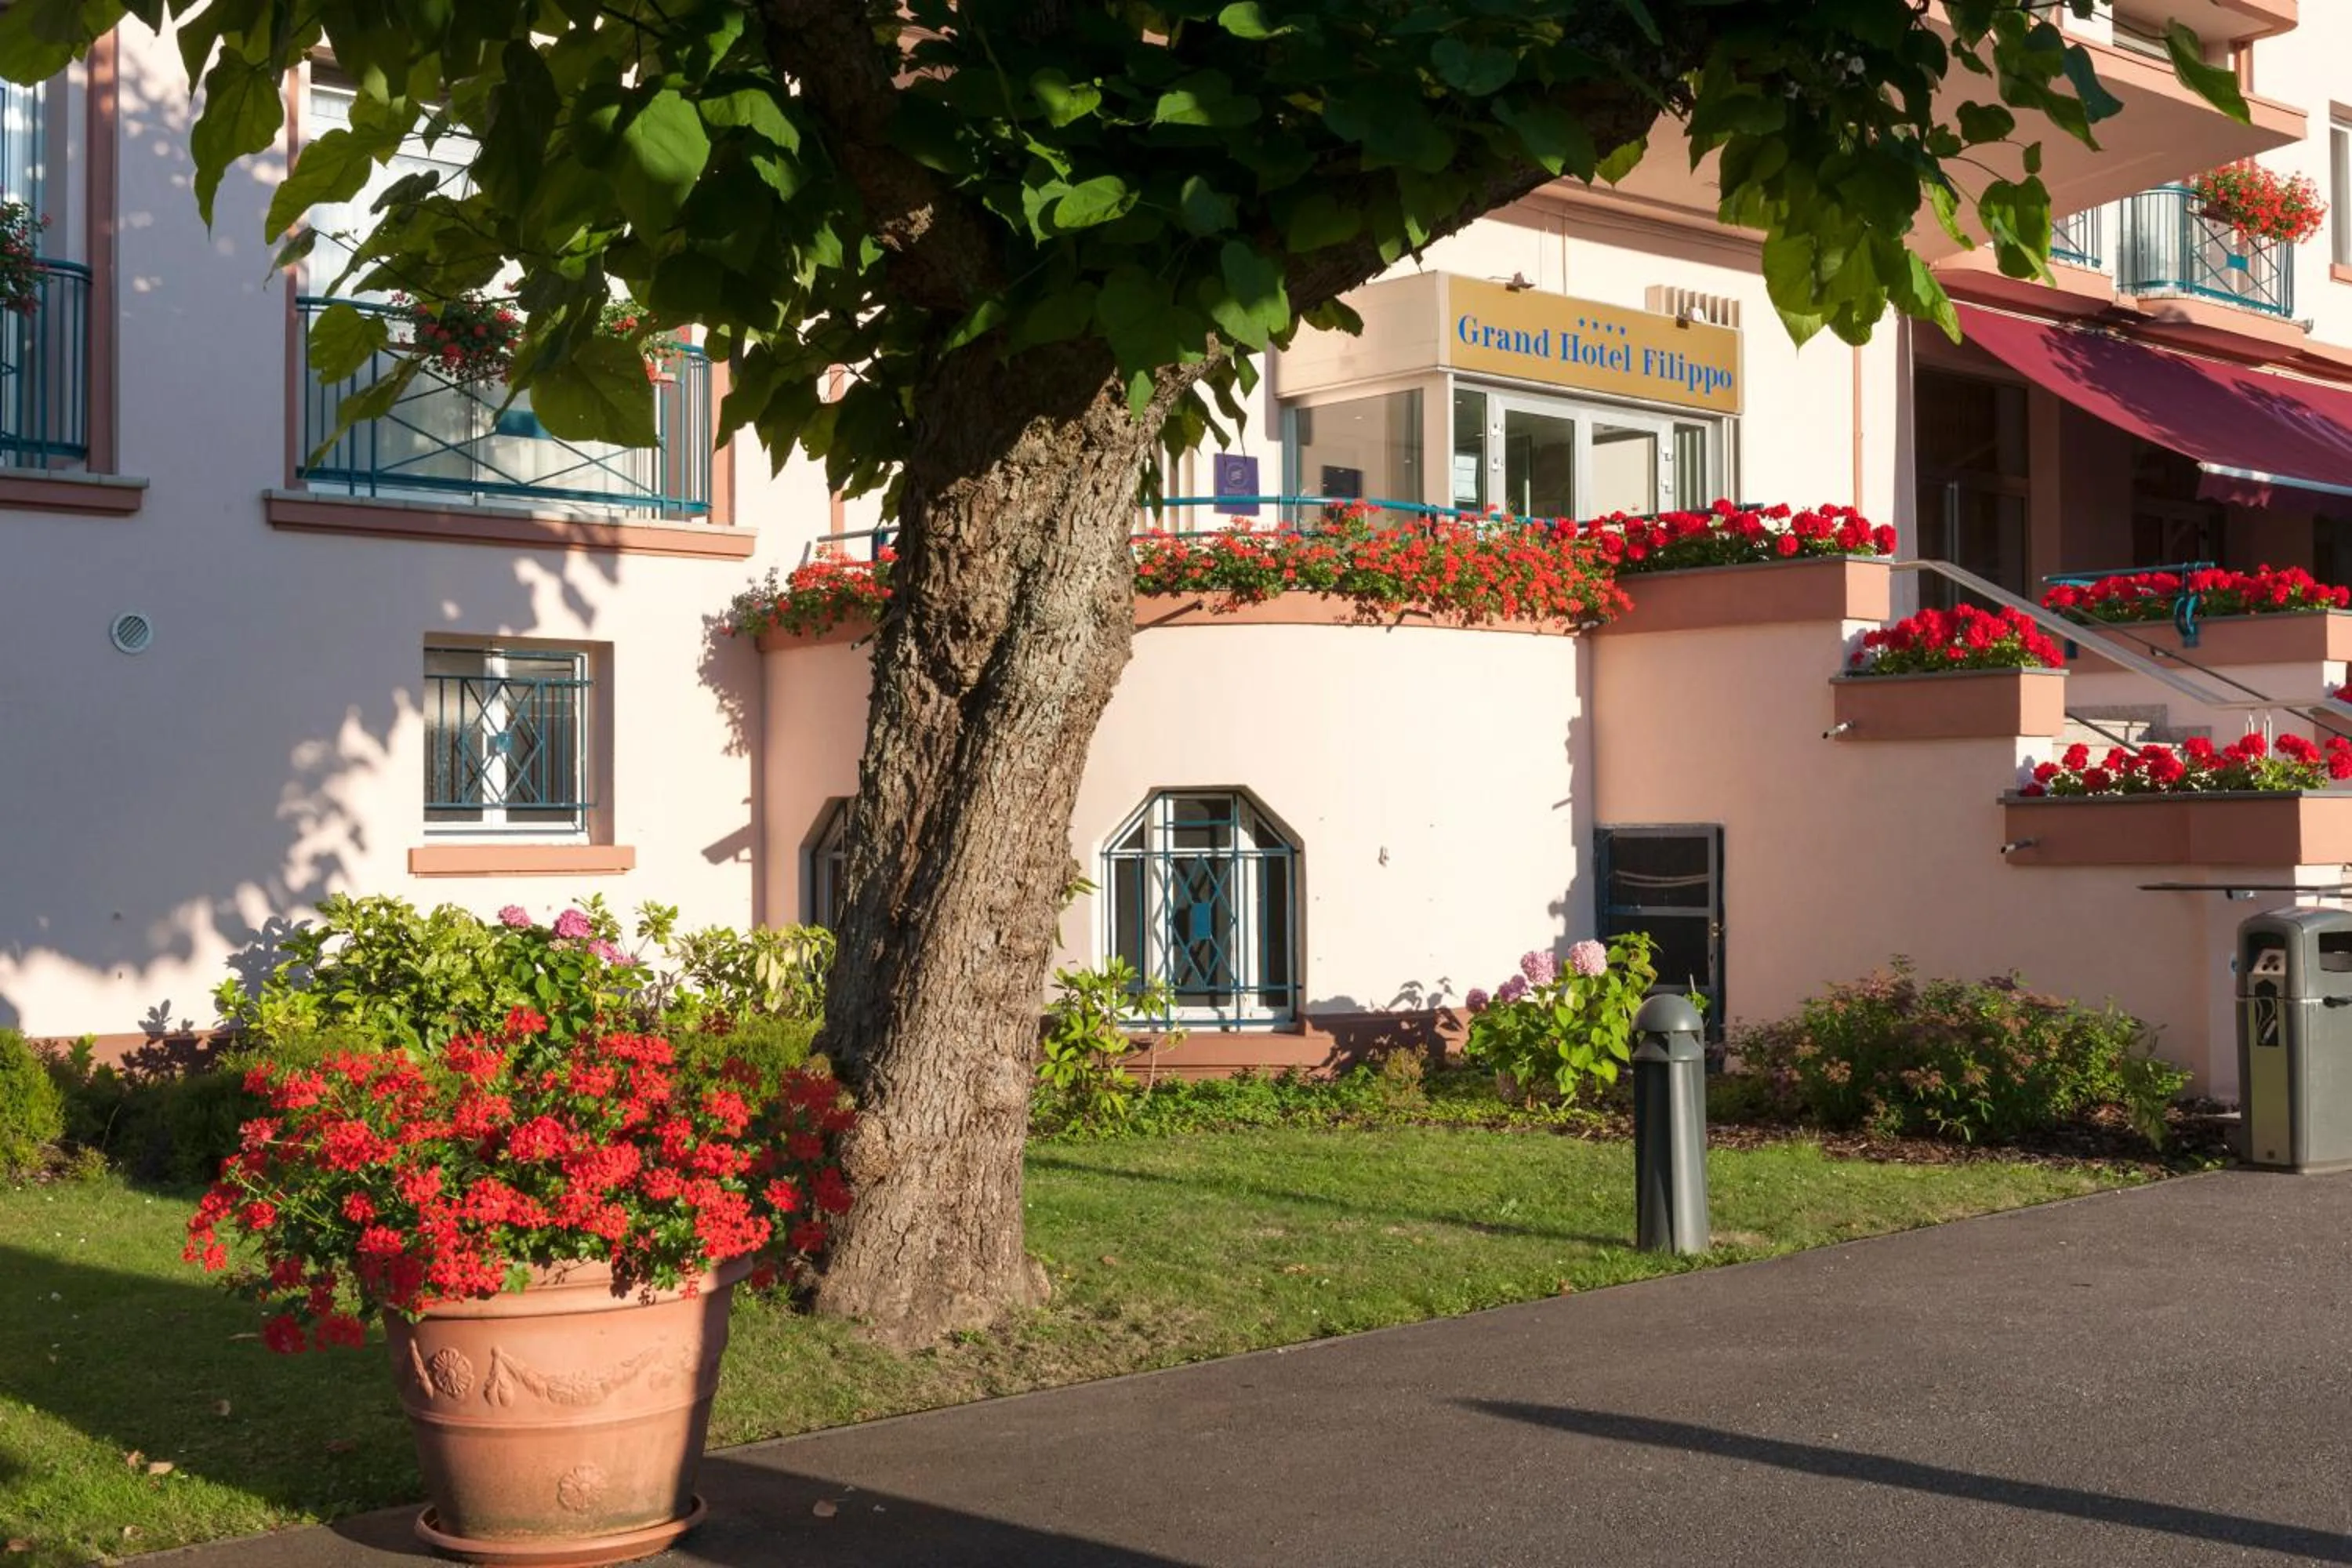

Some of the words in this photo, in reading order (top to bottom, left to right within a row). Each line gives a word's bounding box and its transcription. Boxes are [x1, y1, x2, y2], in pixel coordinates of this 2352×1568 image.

[1457, 314, 1550, 358] Grand
[1560, 332, 1631, 372] Hotel
[1643, 348, 1733, 394] Filippo
